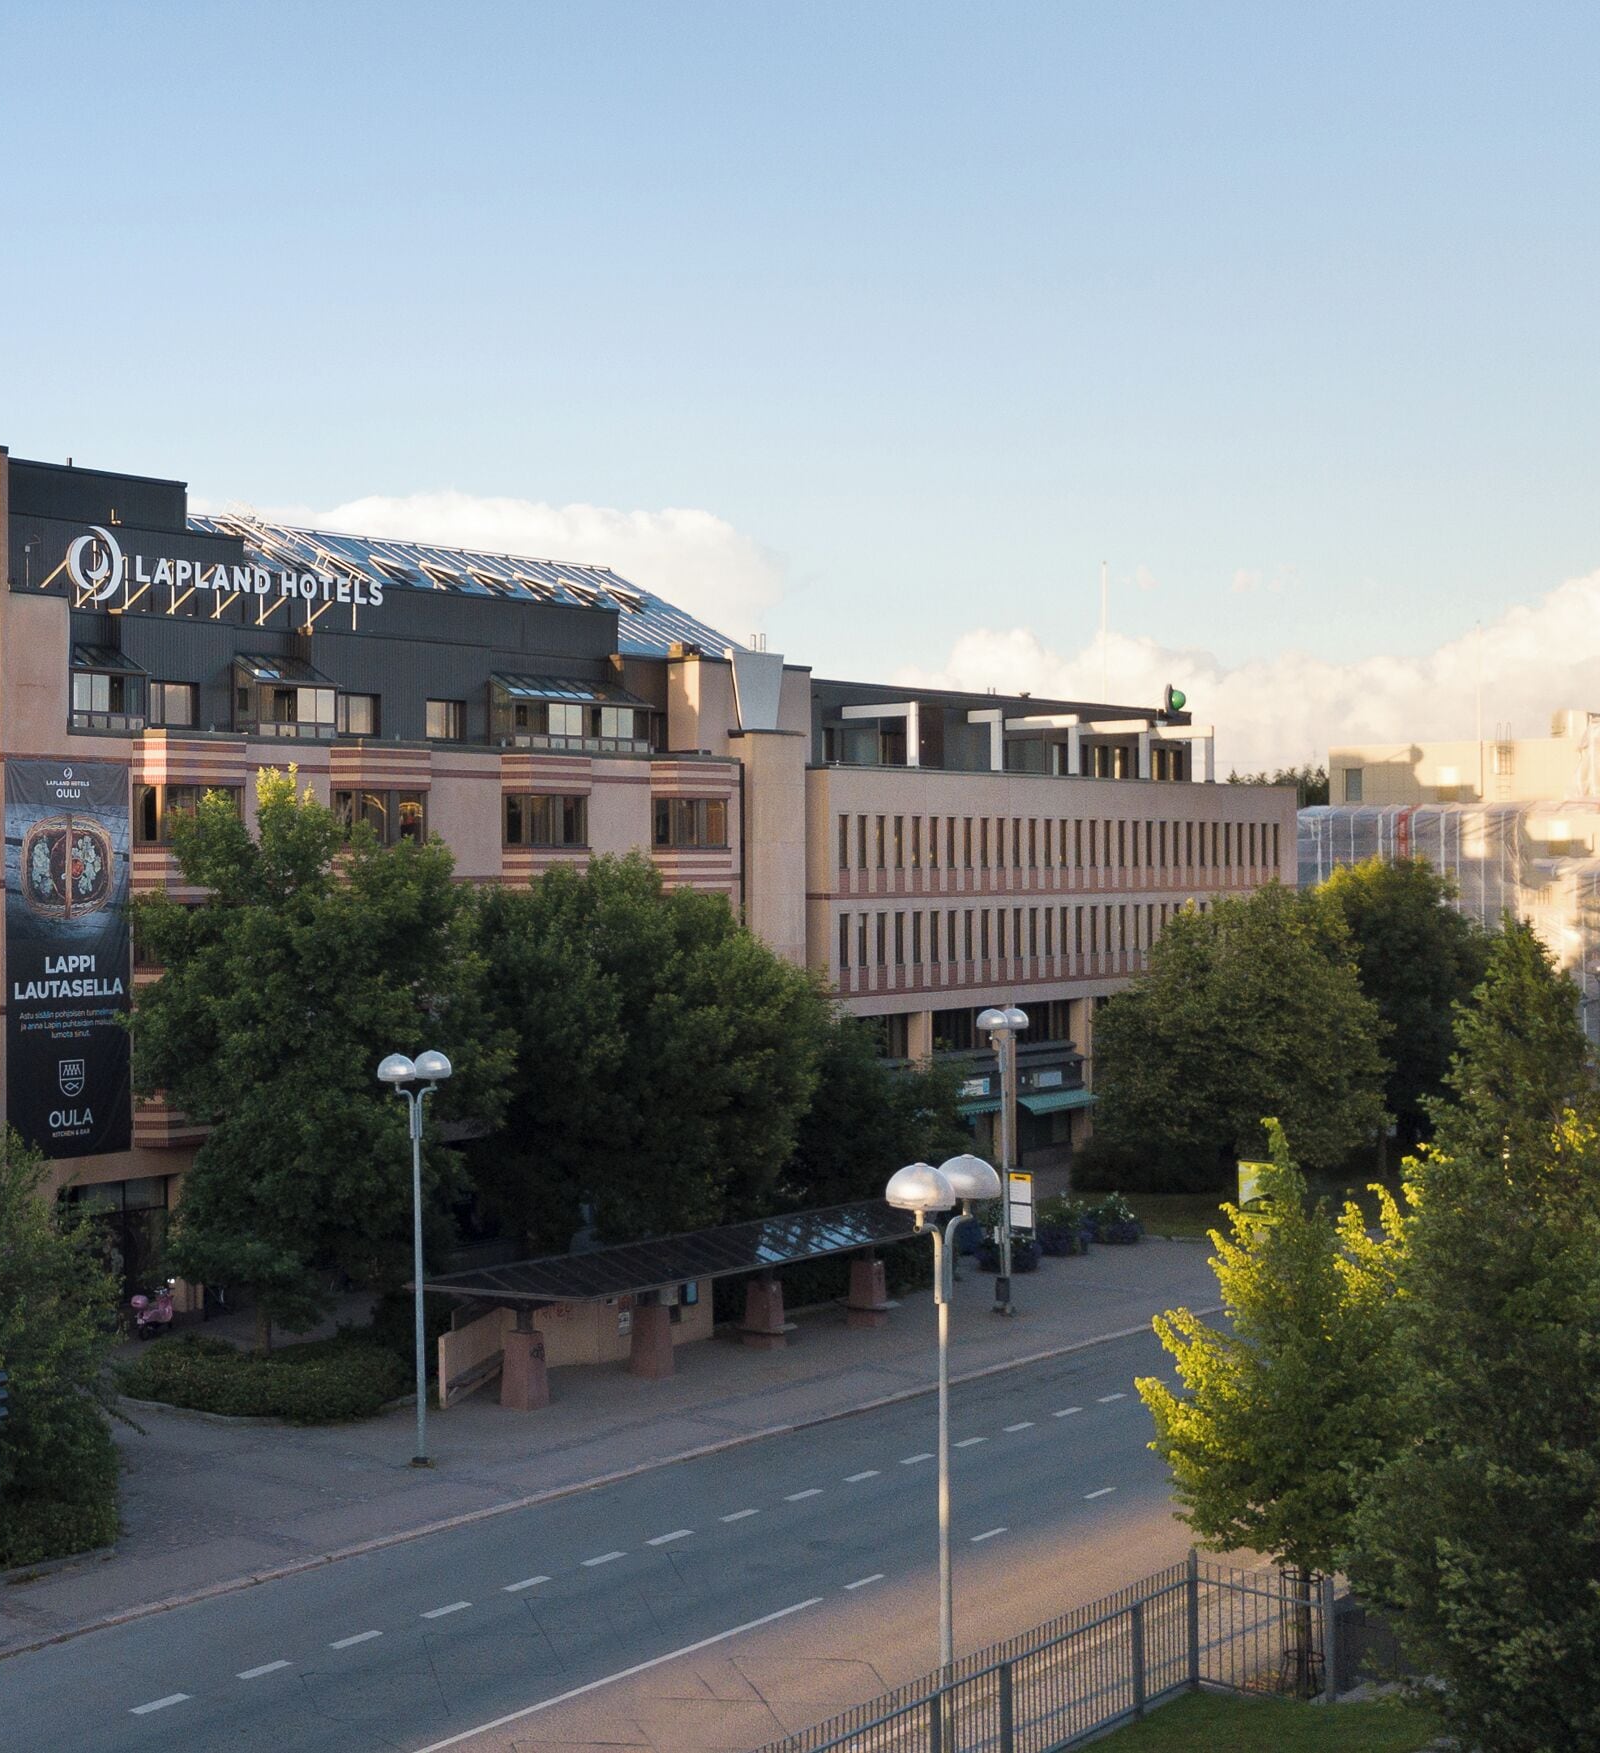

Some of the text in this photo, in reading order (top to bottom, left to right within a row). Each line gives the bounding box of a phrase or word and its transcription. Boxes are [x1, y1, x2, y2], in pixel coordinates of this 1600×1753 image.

[135, 555, 384, 606] LAPLAND HOTELS
[56, 788, 81, 798] OULU
[45, 954, 96, 974] LAPPI
[14, 977, 124, 1000] LAUTASELLA
[49, 1108, 94, 1128] OULA
